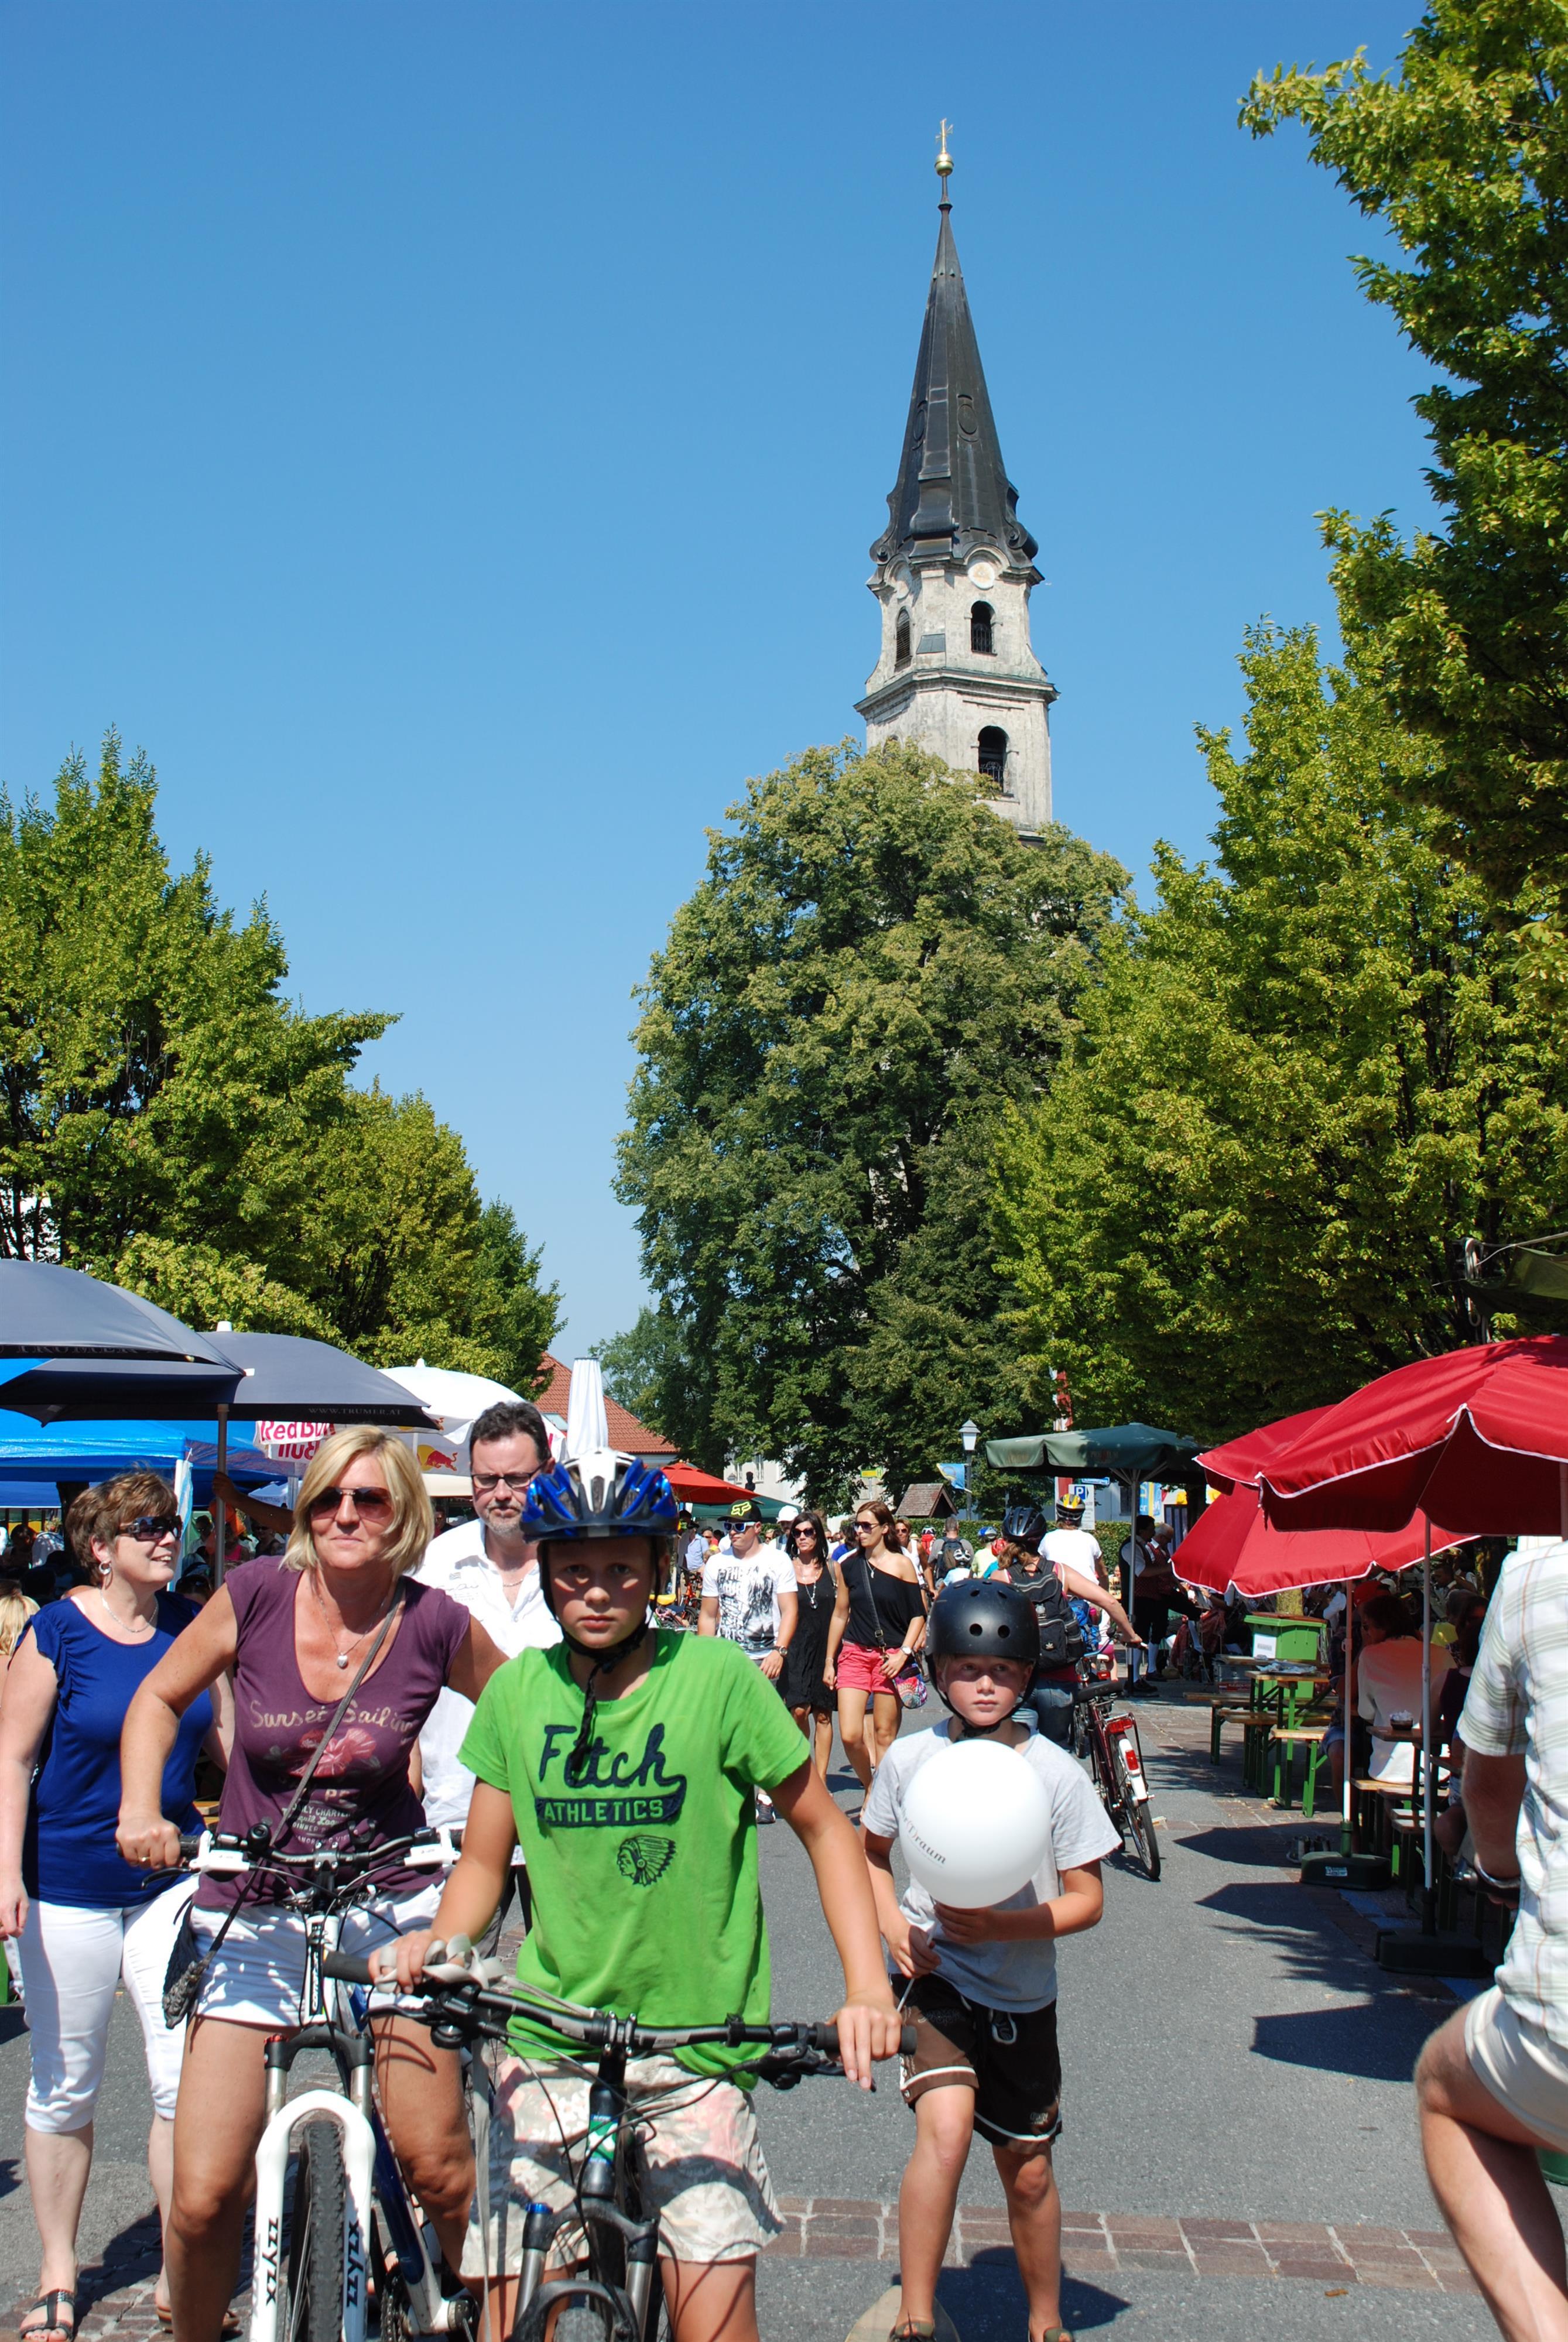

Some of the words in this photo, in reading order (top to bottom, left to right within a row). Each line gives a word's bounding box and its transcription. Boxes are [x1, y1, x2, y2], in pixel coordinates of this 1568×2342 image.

[308, 1408, 403, 1416] WWW.TRUMER.AT
[261, 1421, 297, 1442] Red
[1076, 1487, 1084, 1497] P
[250, 1700, 329, 1728] Sunset
[544, 1799, 663, 1823] ATHLETICS
[262, 2217, 279, 2306] ZZYZX
[347, 2220, 364, 2307] ZZYZX
